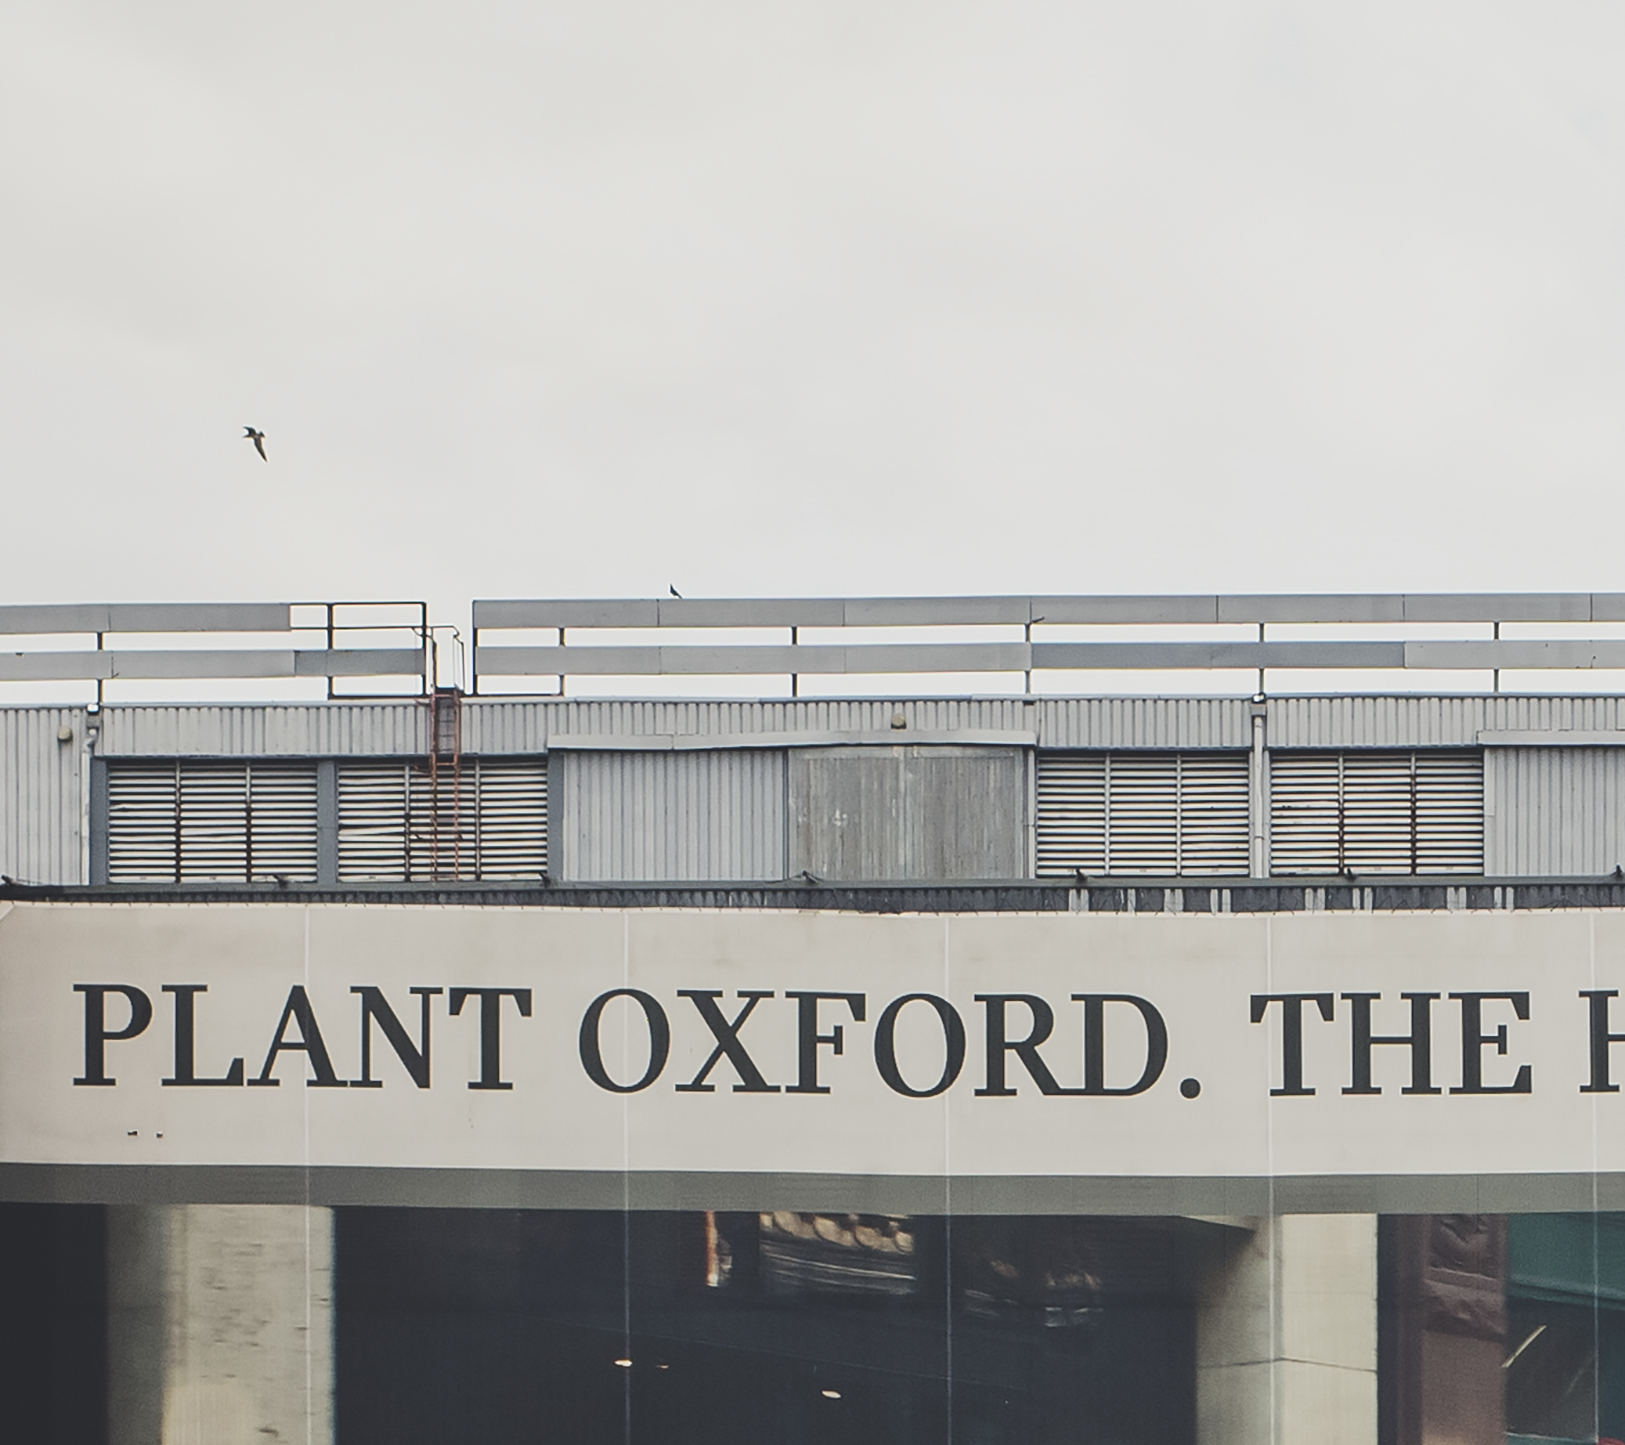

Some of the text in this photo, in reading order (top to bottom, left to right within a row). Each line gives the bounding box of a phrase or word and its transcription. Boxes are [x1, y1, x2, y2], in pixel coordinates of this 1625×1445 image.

[74, 984, 531, 1089] PLANT
[580, 989, 1200, 1098] OXFORD.
[1251, 992, 1531, 1096] THE
